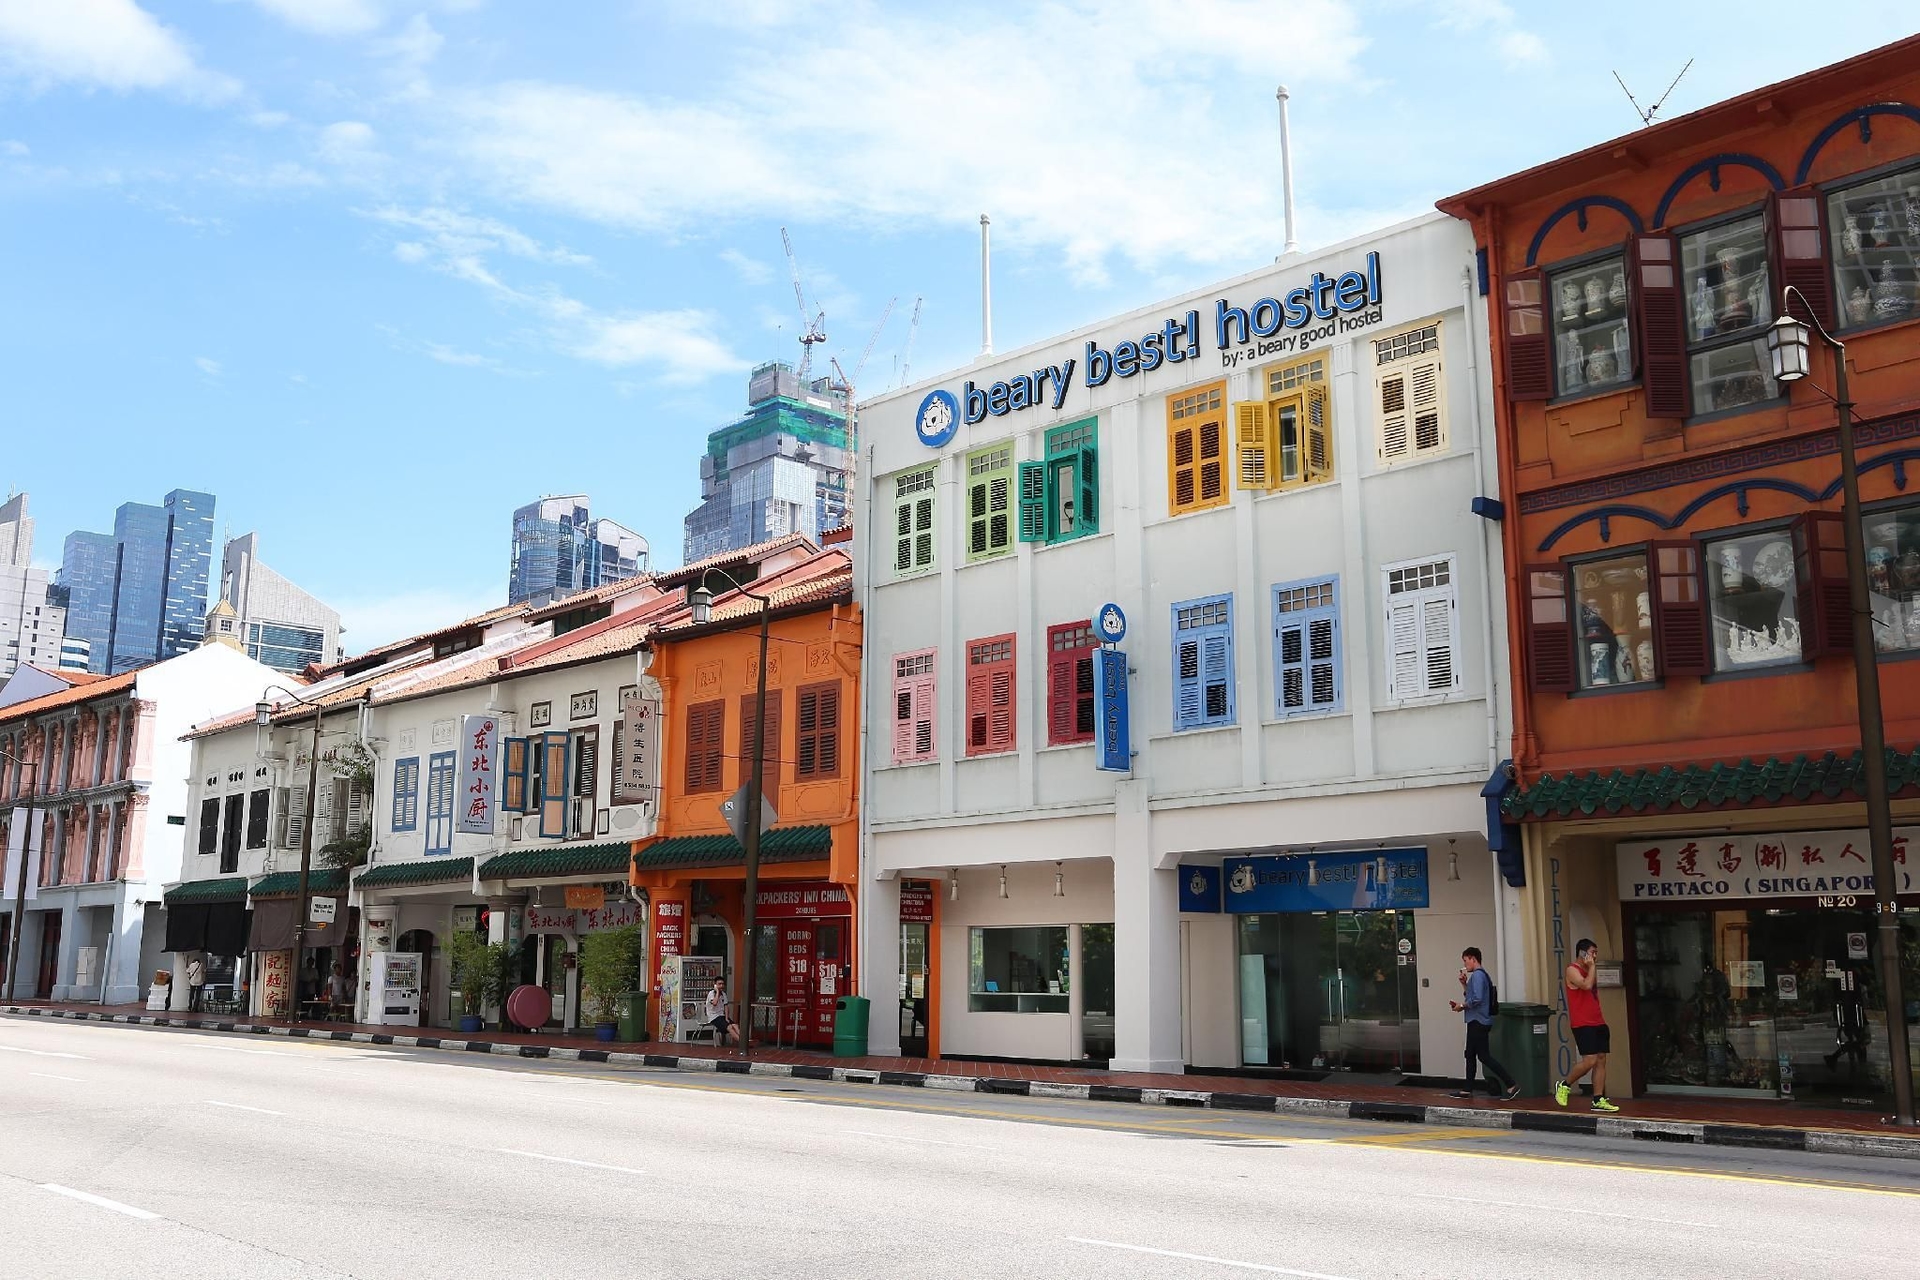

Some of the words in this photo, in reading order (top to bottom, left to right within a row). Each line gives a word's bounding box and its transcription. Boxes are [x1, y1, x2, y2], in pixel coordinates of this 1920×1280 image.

[964, 359, 1076, 424] beary
[1085, 309, 1201, 388] best!
[1216, 251, 1382, 350] hostel
[1222, 350, 1244, 368] by:
[1247, 348, 1255, 360] a
[1257, 334, 1297, 356] beary
[1300, 320, 1336, 350] good
[1340, 305, 1383, 333] hostel
[1105, 703, 1121, 753] beary
[467, 728, 490, 821] 东北小厨
[1258, 867, 1305, 886] beary
[1633, 880, 1730, 897] PERTACO
[804, 891, 818, 904] INN
[1838, 895, 1857, 907] 20
[788, 945, 807, 954] BEDS
[1549, 858, 1572, 1077] PERTACO
